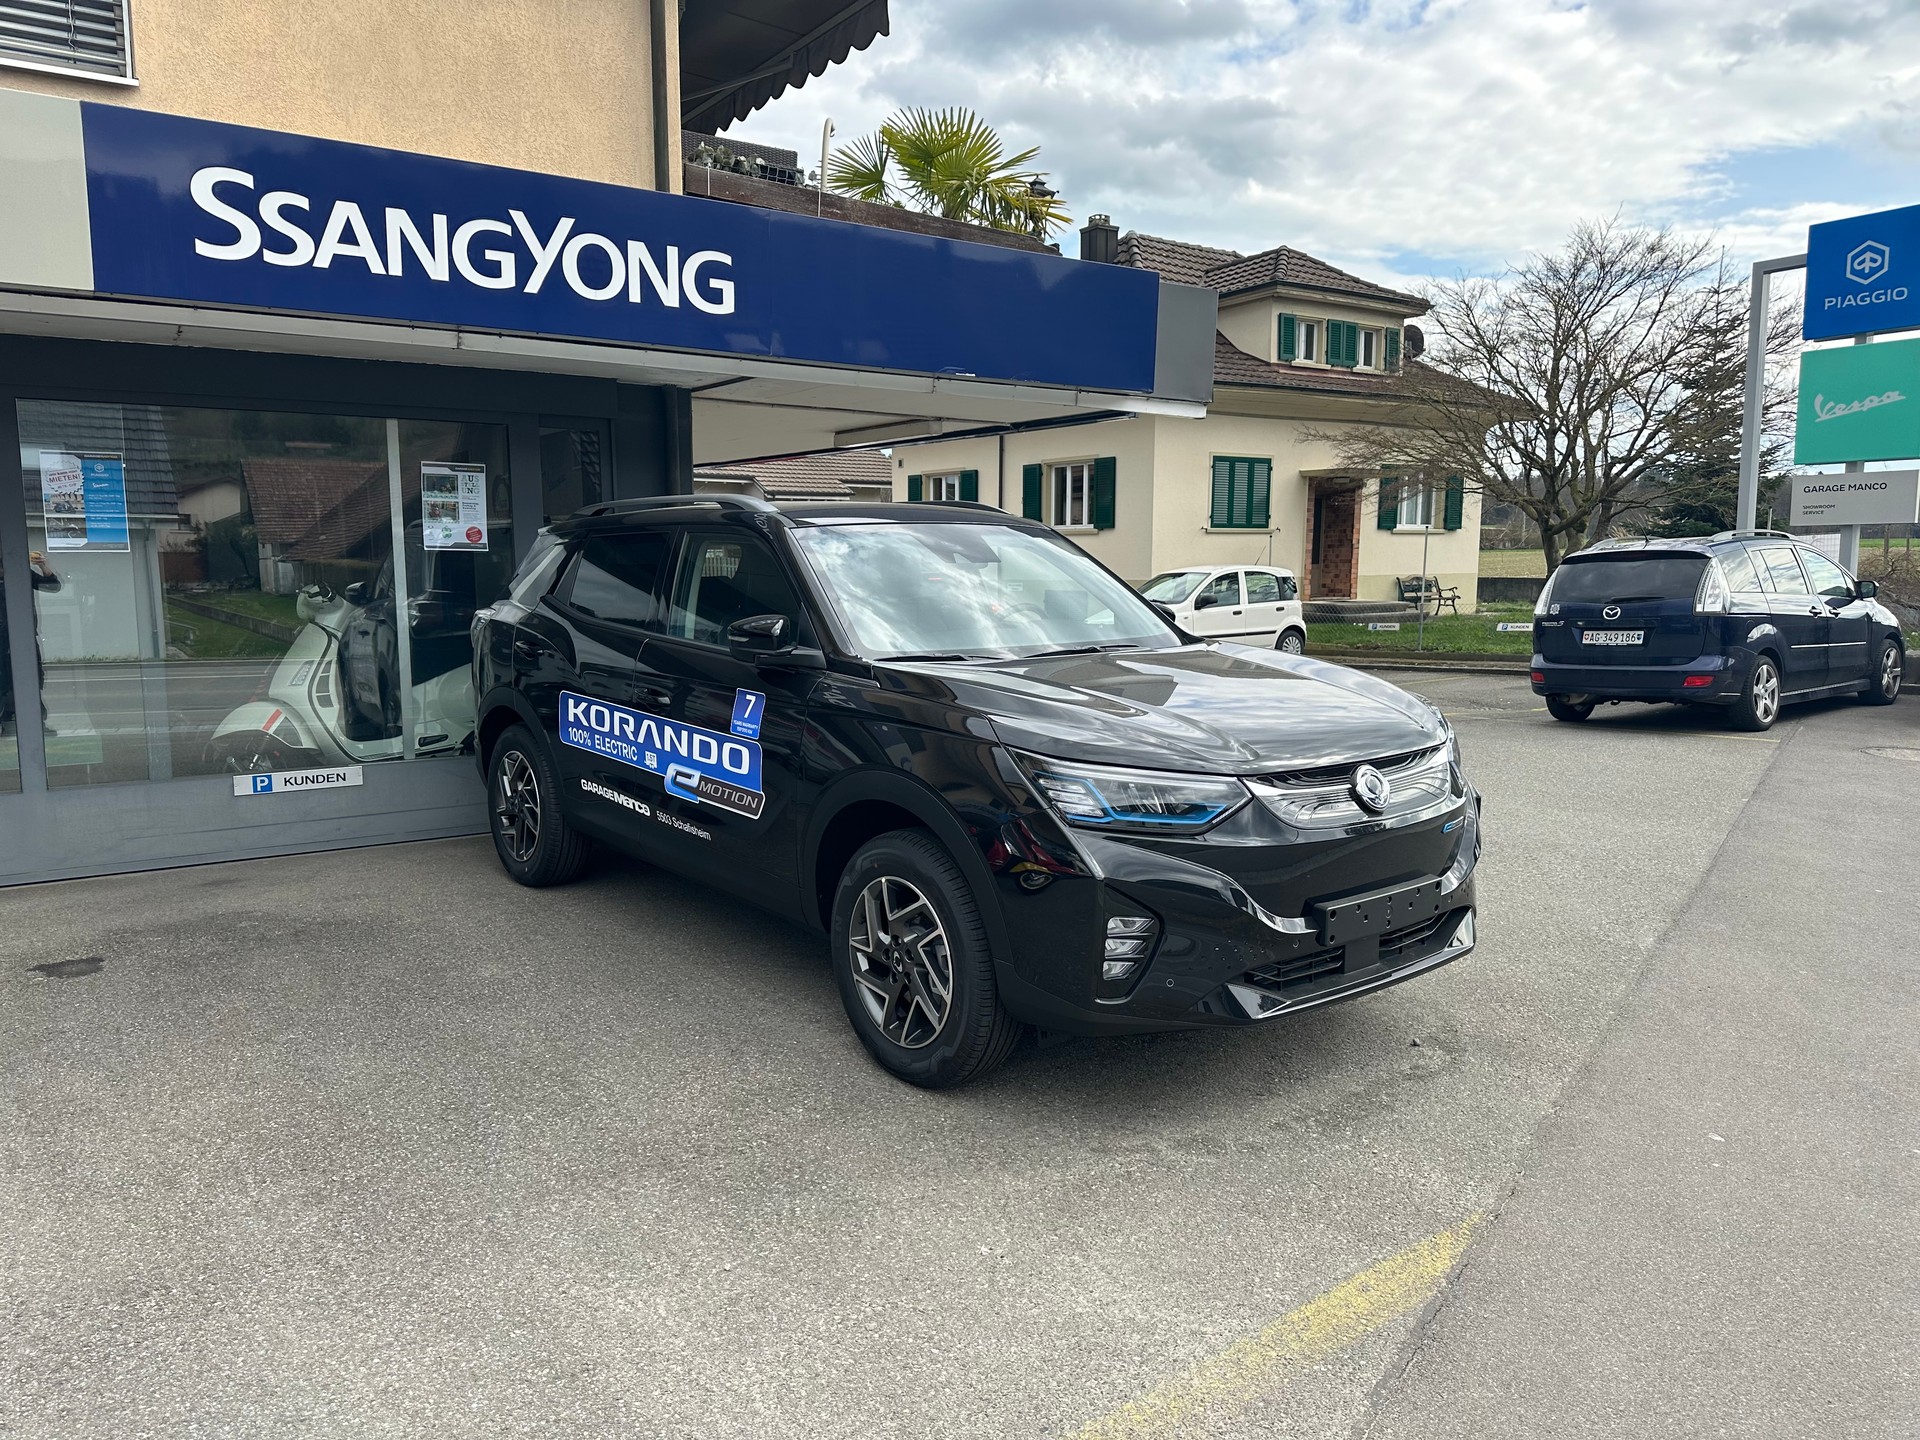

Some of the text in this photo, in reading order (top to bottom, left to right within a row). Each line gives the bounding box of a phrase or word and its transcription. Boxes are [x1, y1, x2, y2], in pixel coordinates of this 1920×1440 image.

[1824, 287, 1908, 311] PIAGGIO
[1814, 391, 1906, 422] Vespa
[1803, 482, 1888, 494] GARAGE MANCO
[744, 694, 756, 719] 7
[568, 698, 750, 775] KORANDO
[568, 727, 638, 761] 100% ELECTRIC
[284, 772, 347, 787] KUNDEN
[656, 810, 672, 826] 5503
